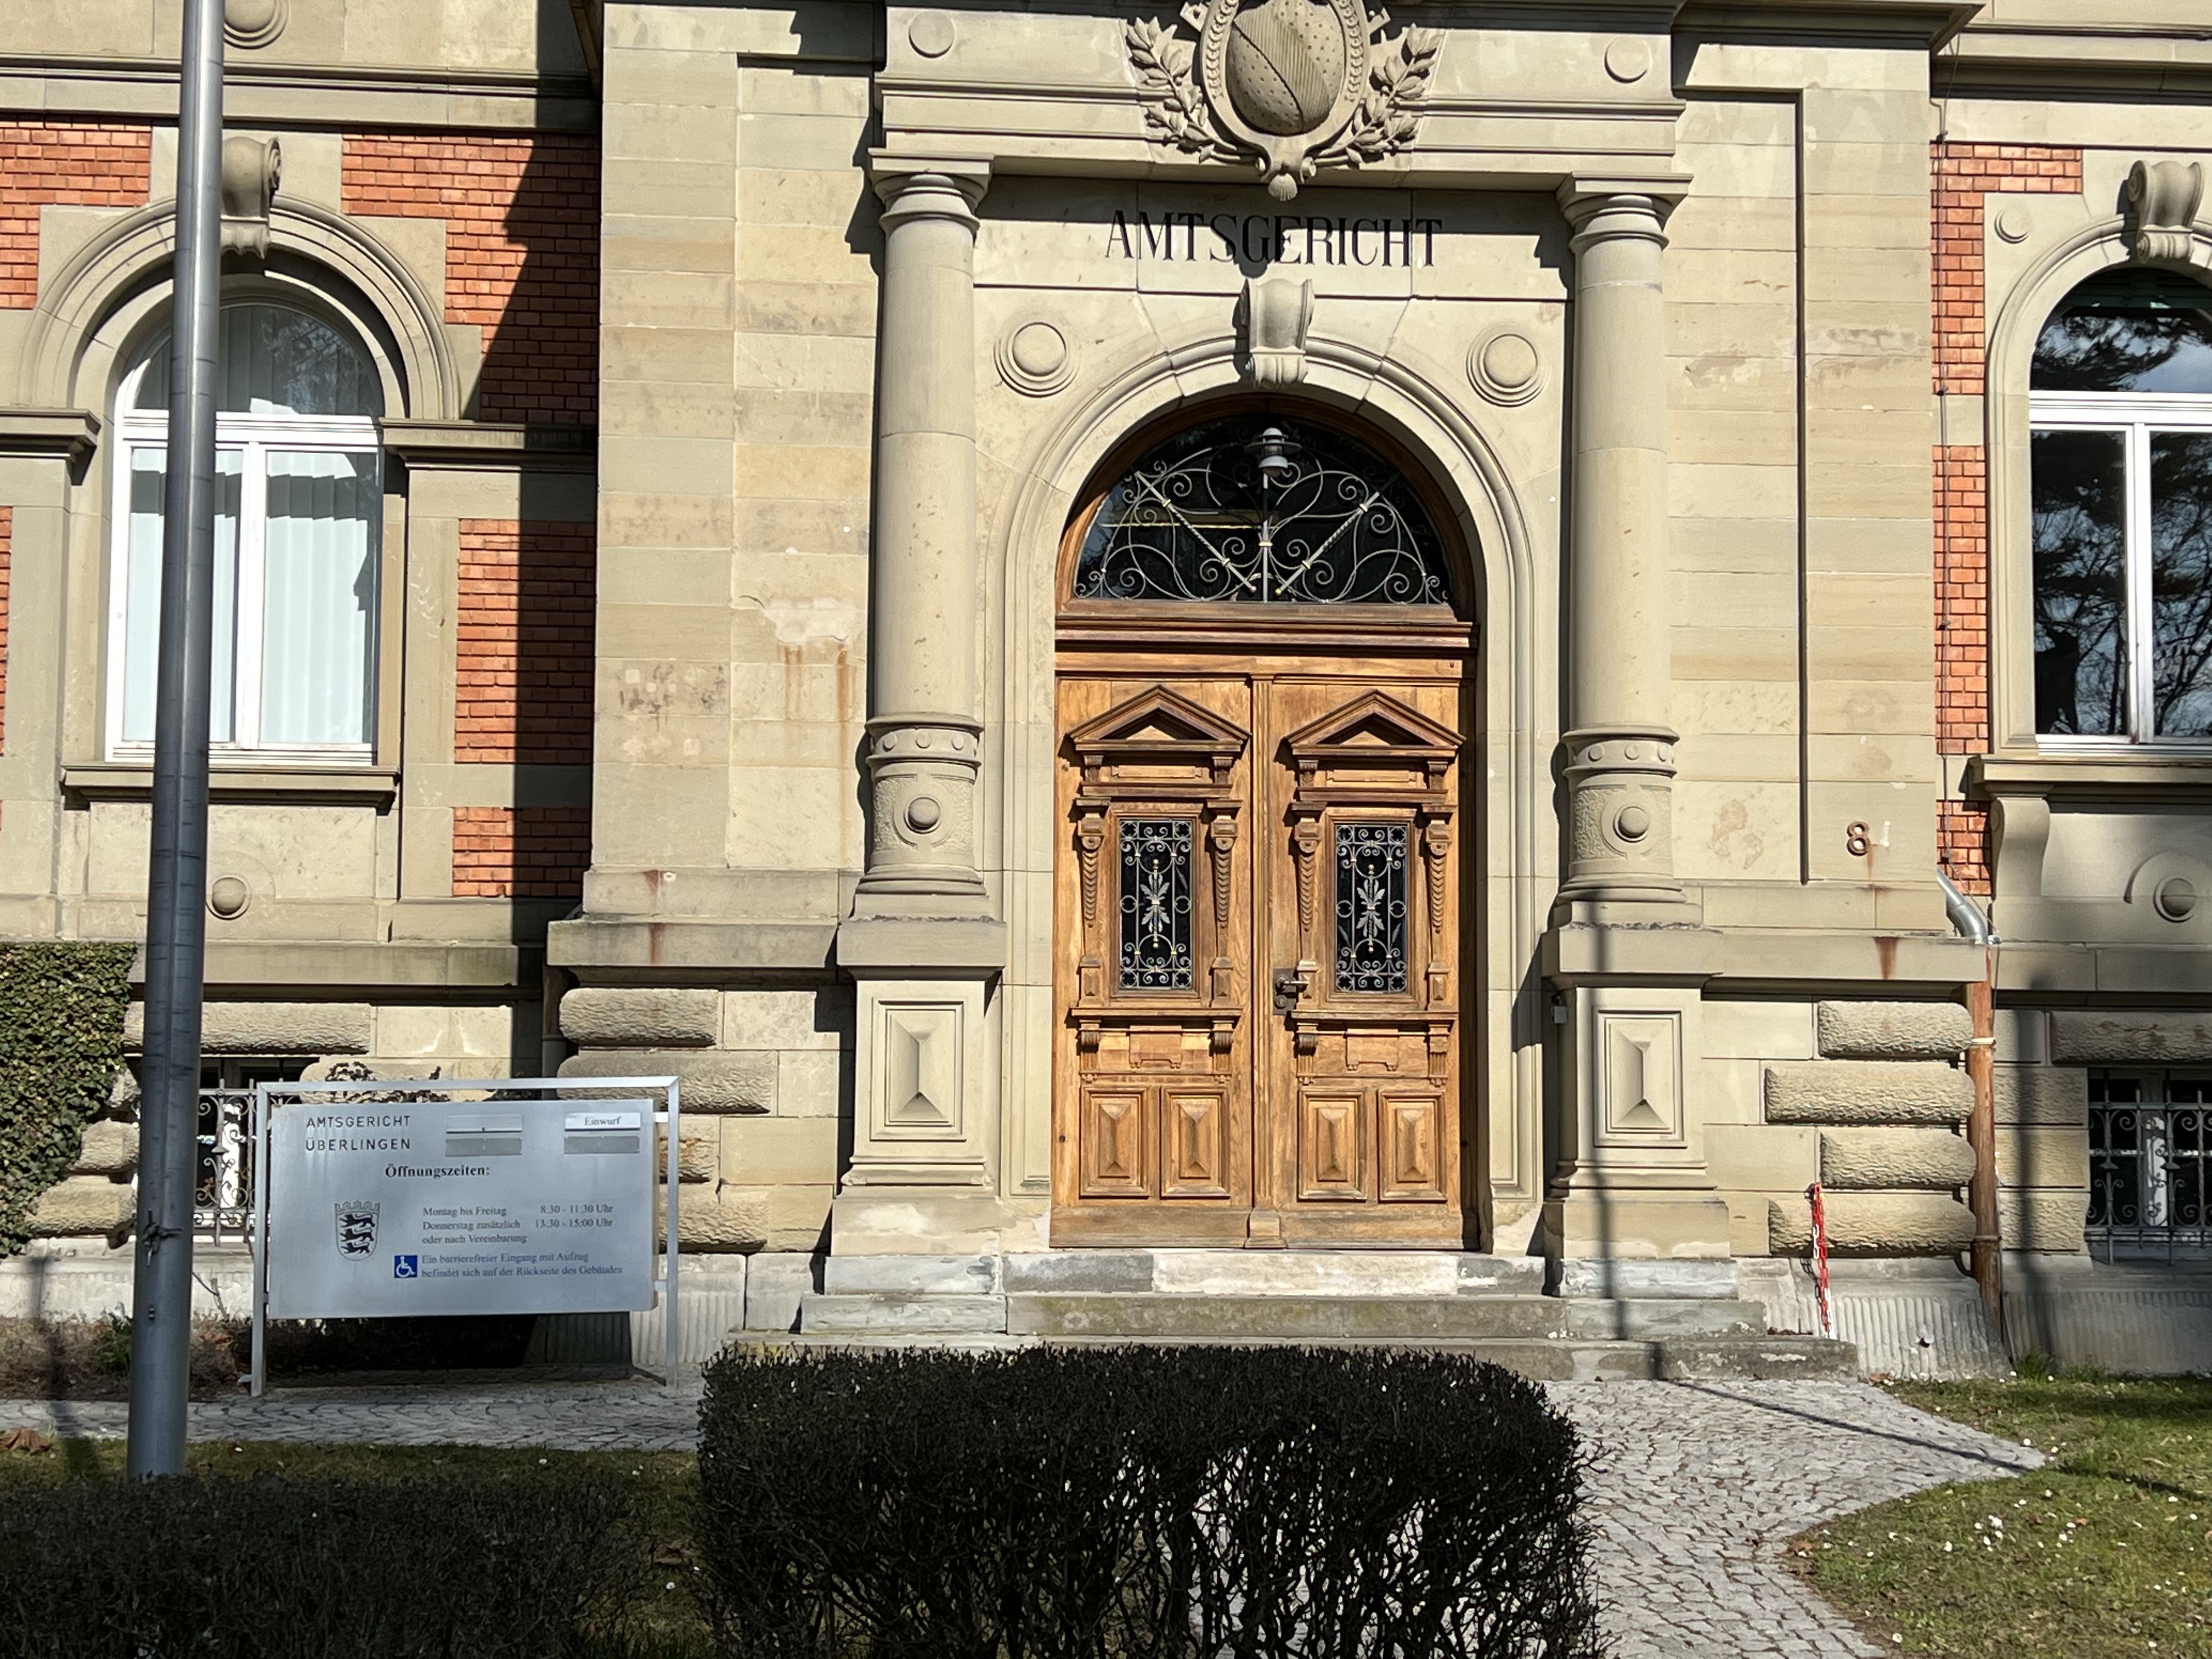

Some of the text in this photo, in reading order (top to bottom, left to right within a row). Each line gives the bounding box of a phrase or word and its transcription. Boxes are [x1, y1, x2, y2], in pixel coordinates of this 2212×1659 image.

[1104, 209, 1442, 268] AMTSGERICHT
[1846, 821, 1871, 856] 8
[306, 1115, 411, 1128] AMTSGERICHT
[584, 1116, 622, 1126] Einwurf
[306, 1136, 410, 1152] ÜBERLINGEN
[385, 1163, 491, 1179] Öffnungszeiten:
[422, 1207, 458, 1218] Montag
[460, 1206, 473, 1216] bis
[476, 1206, 507, 1217] Freitag
[596, 1204, 613, 1214] Uhr
[422, 1221, 474, 1231] Donnerstag
[476, 1220, 521, 1229] zusätzlich
[535, 1218, 560, 1228] 13:30
[569, 1218, 594, 1227] 15:00
[596, 1217, 613, 1227] Uhr
[422, 1233, 528, 1244] oder nach Vereinbarung
[421, 1251, 590, 1264] Ein barrierefreier Eingang mit Aufzug
[421, 1265, 623, 1278] befindet sich auf der Rückseite des Gebäudes
